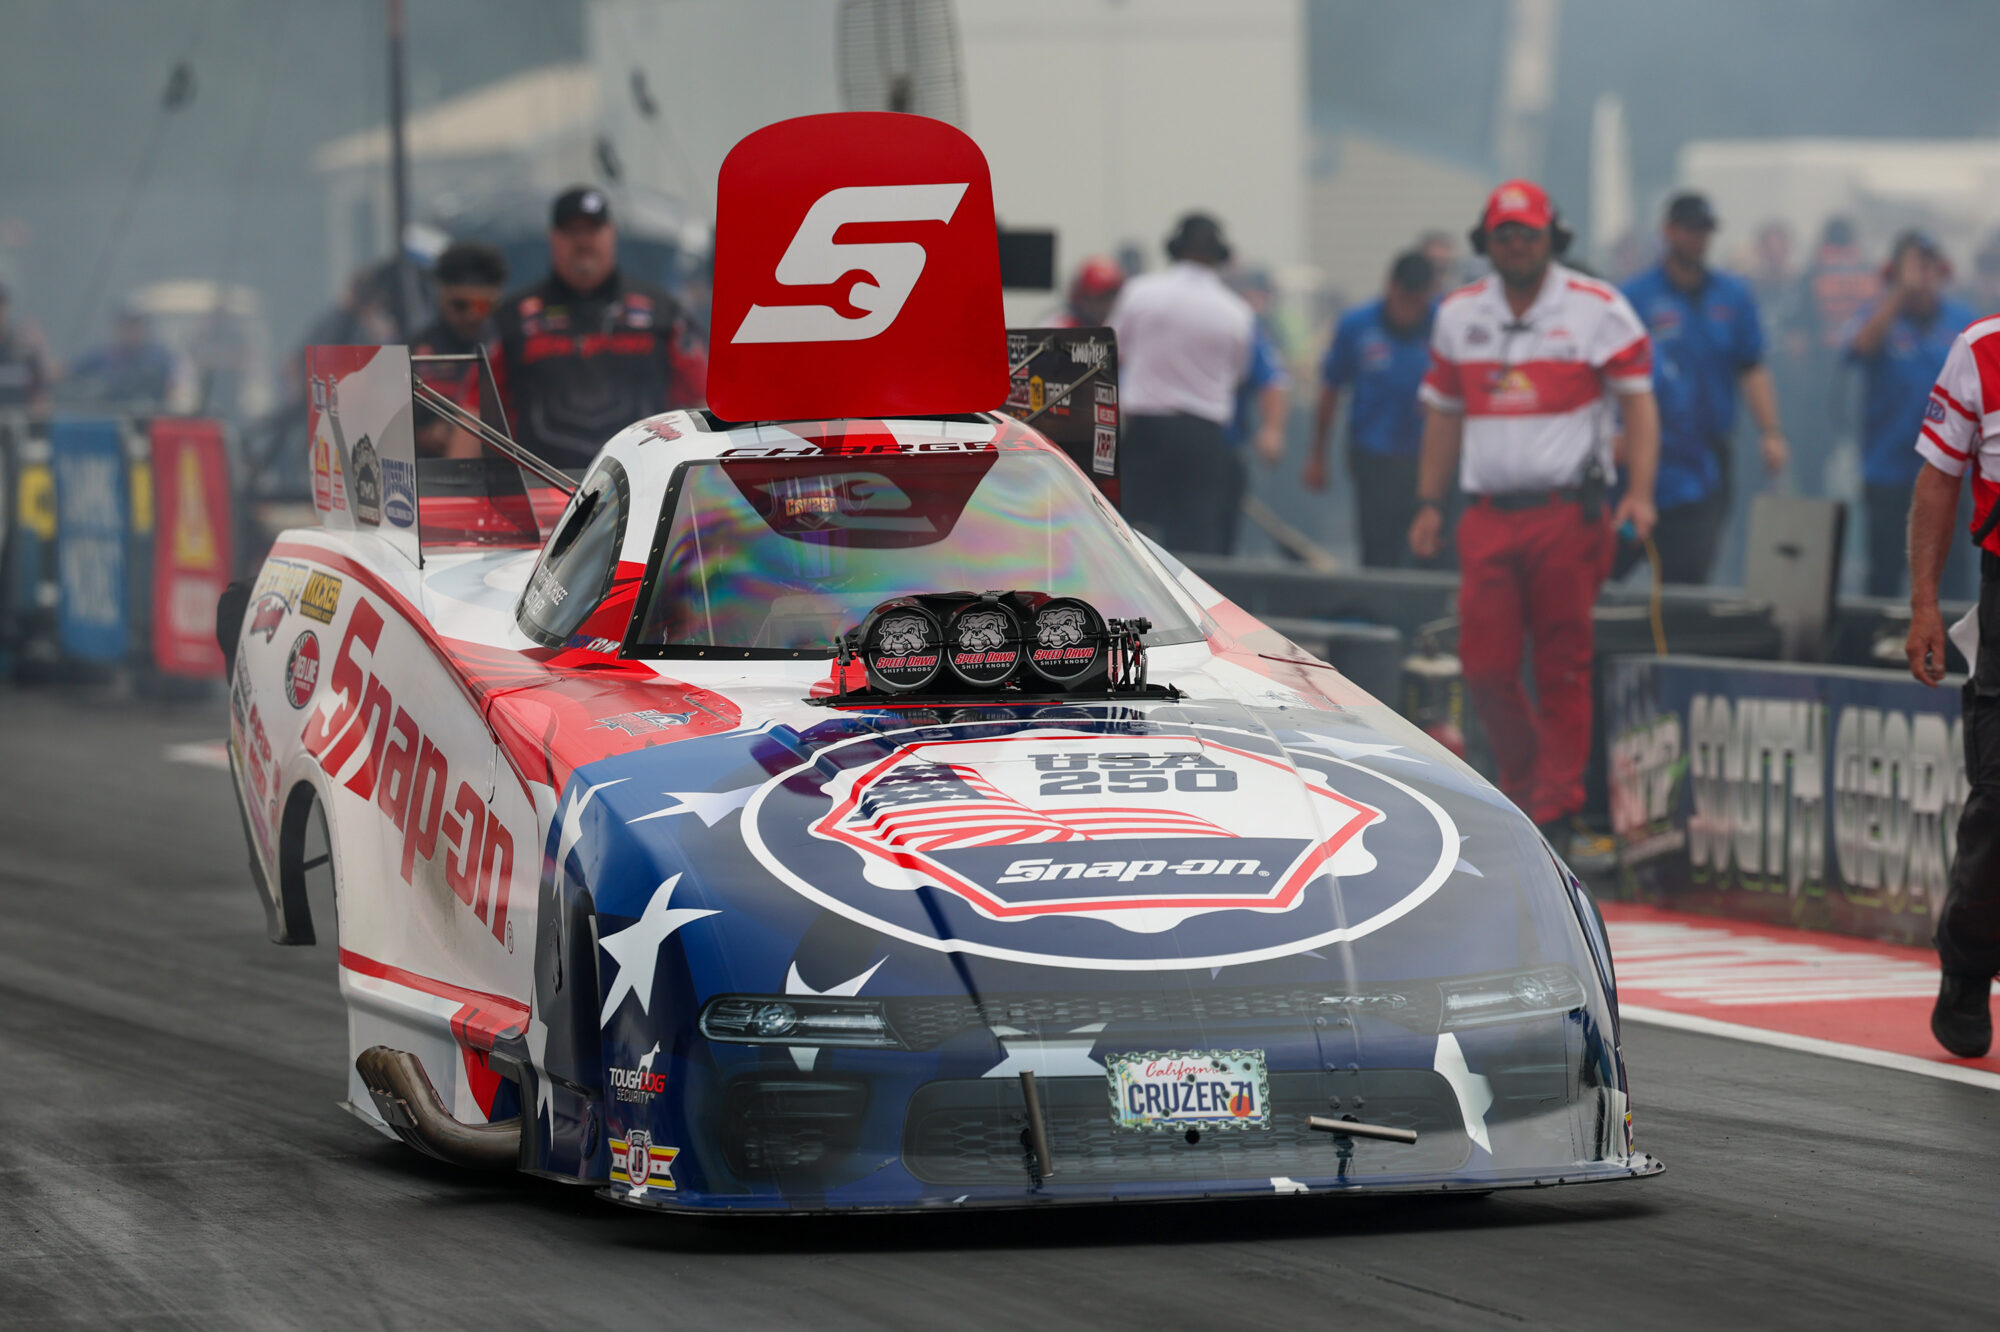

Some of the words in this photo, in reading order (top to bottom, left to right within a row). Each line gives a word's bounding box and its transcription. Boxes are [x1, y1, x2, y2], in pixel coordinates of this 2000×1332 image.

[716, 441, 1039, 457] CHARGER
[876, 657, 908, 669] SPEED
[907, 655, 937, 668] DAWG
[955, 653, 986, 665] SPEED
[985, 651, 1016, 663] DAWG
[1033, 649, 1064, 661] SPEED
[1064, 647, 1095, 659] DAWG
[1027, 752, 1226, 771] USA
[1040, 769, 1238, 795] 250
[616, 1087, 650, 1104] SECURITY
